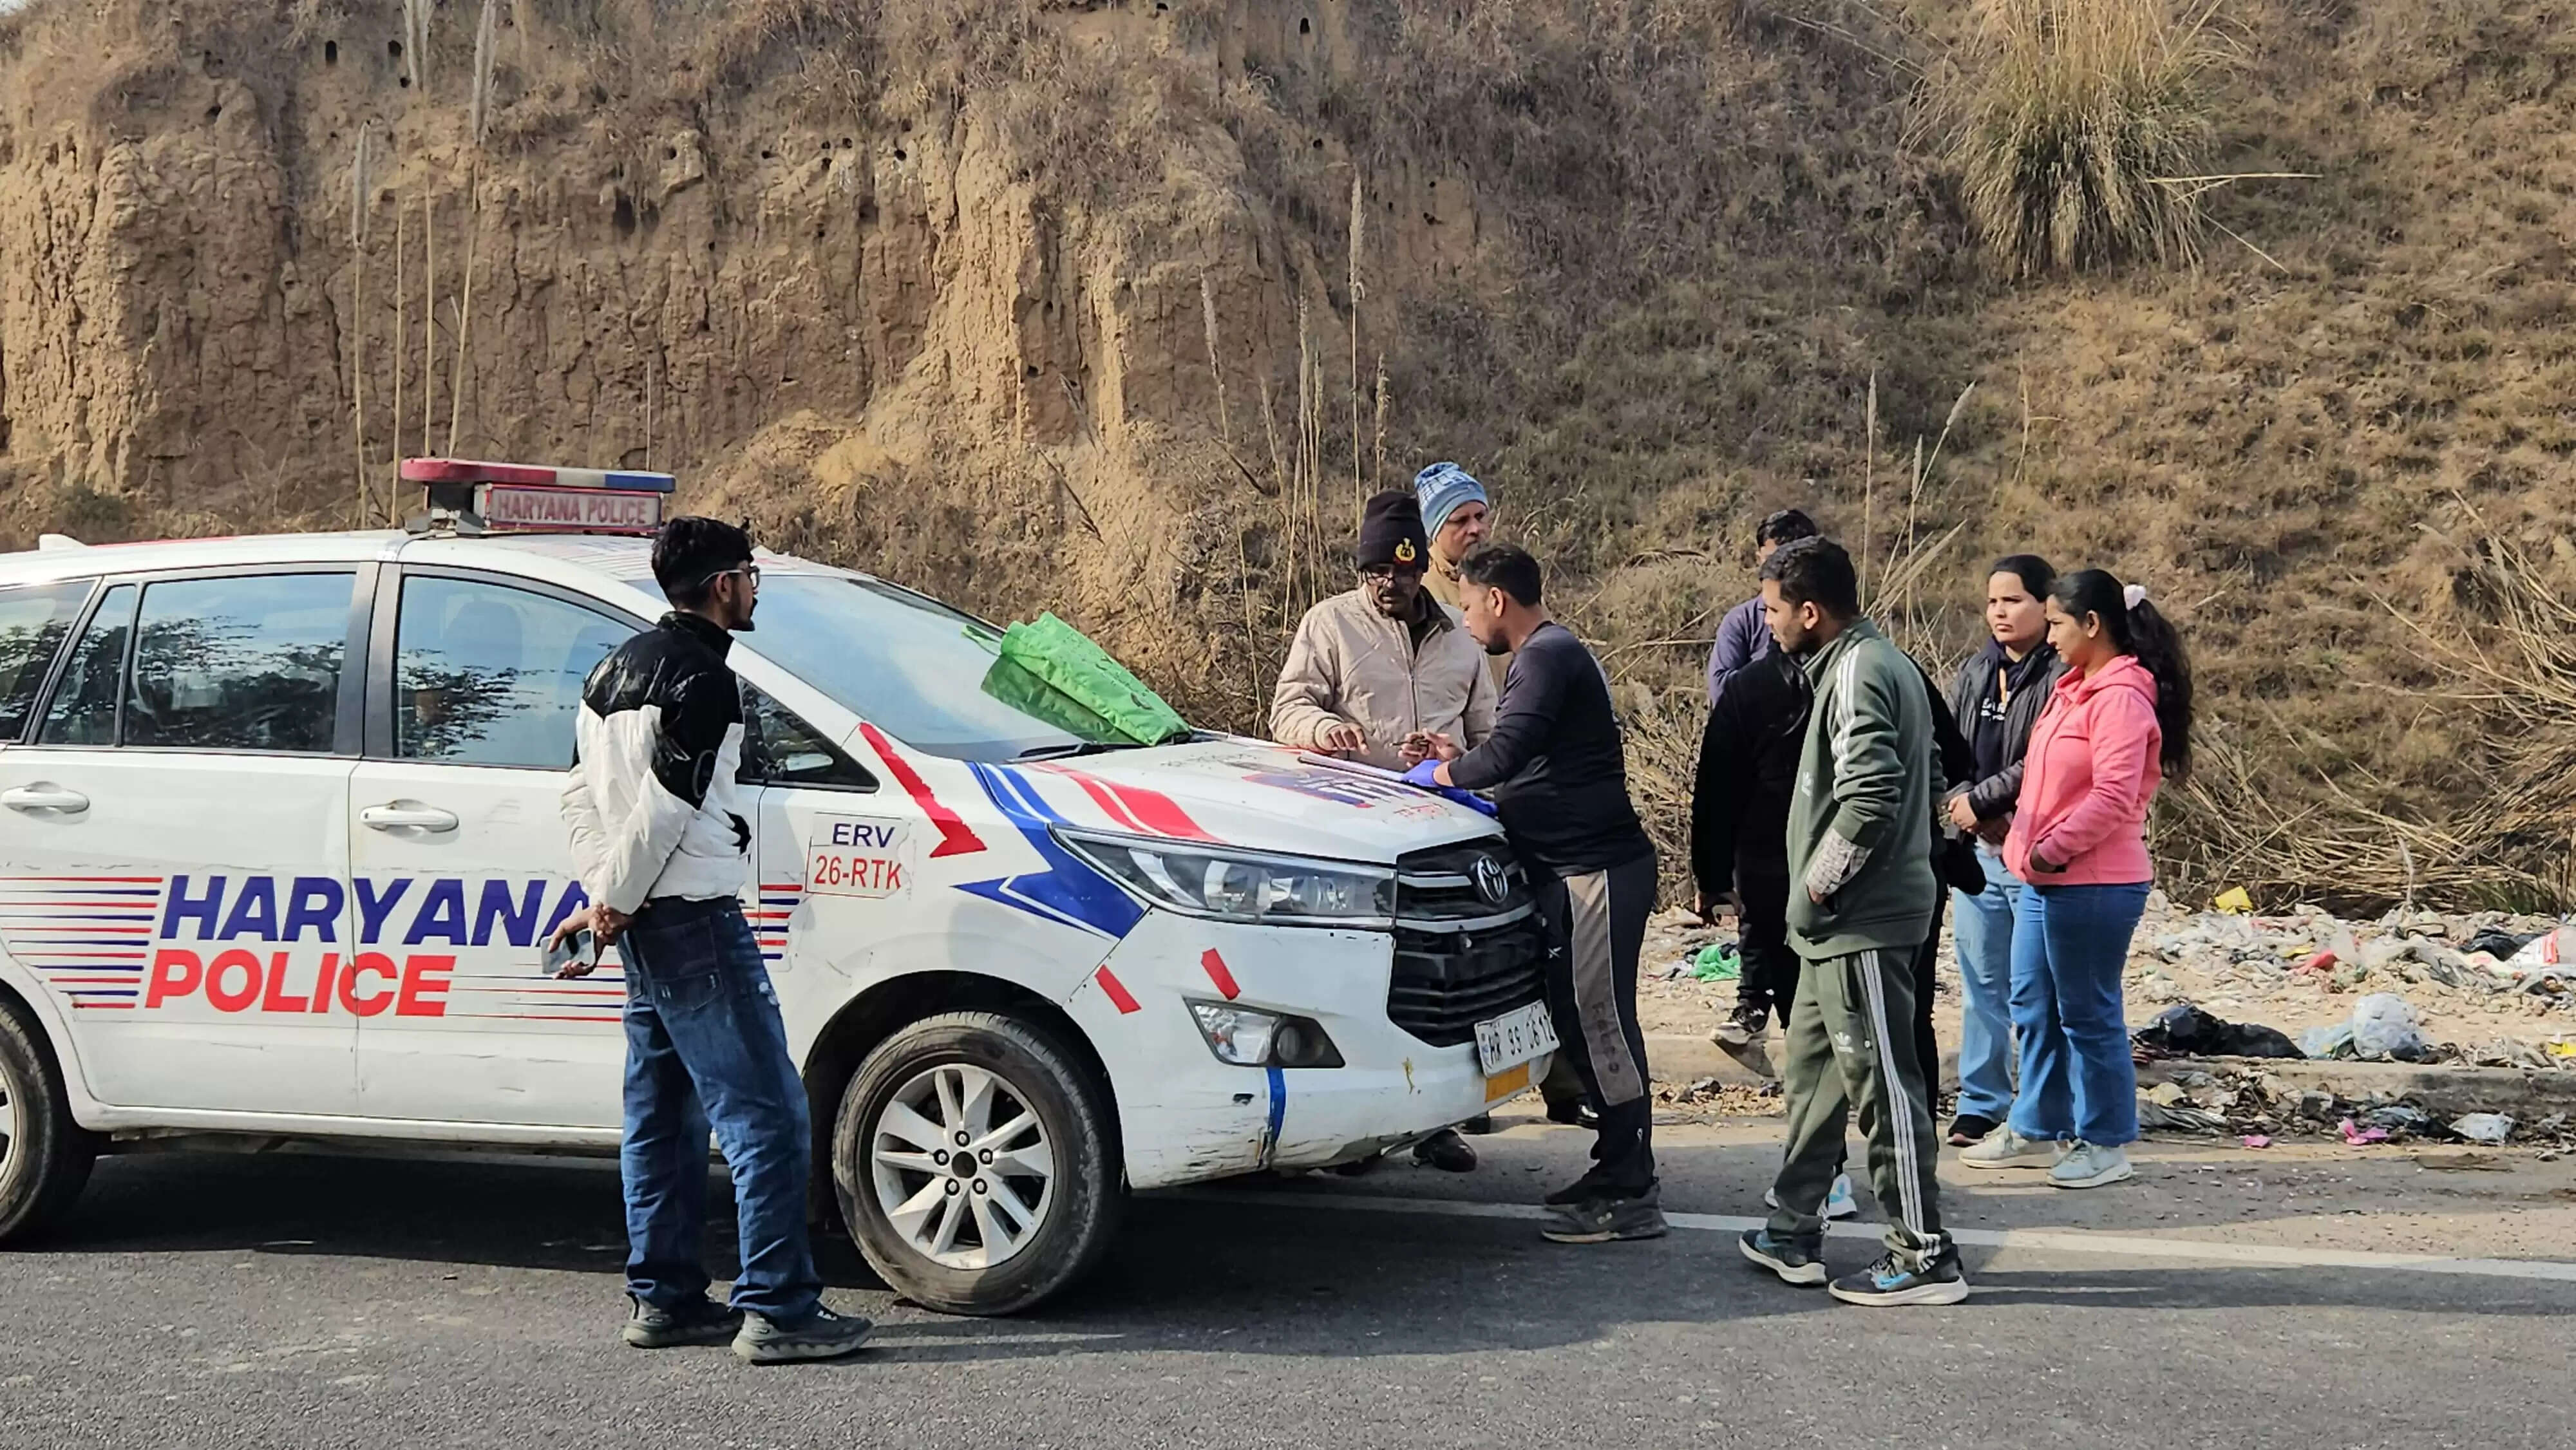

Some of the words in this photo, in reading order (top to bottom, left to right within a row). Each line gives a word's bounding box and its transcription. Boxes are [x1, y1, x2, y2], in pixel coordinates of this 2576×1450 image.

[498, 493, 580, 521] HARYANA
[588, 498, 647, 524] POLICE
[832, 823, 895, 848] ERV
[813, 855, 902, 890] 26-RTK
[145, 949, 457, 1017] POLICE
